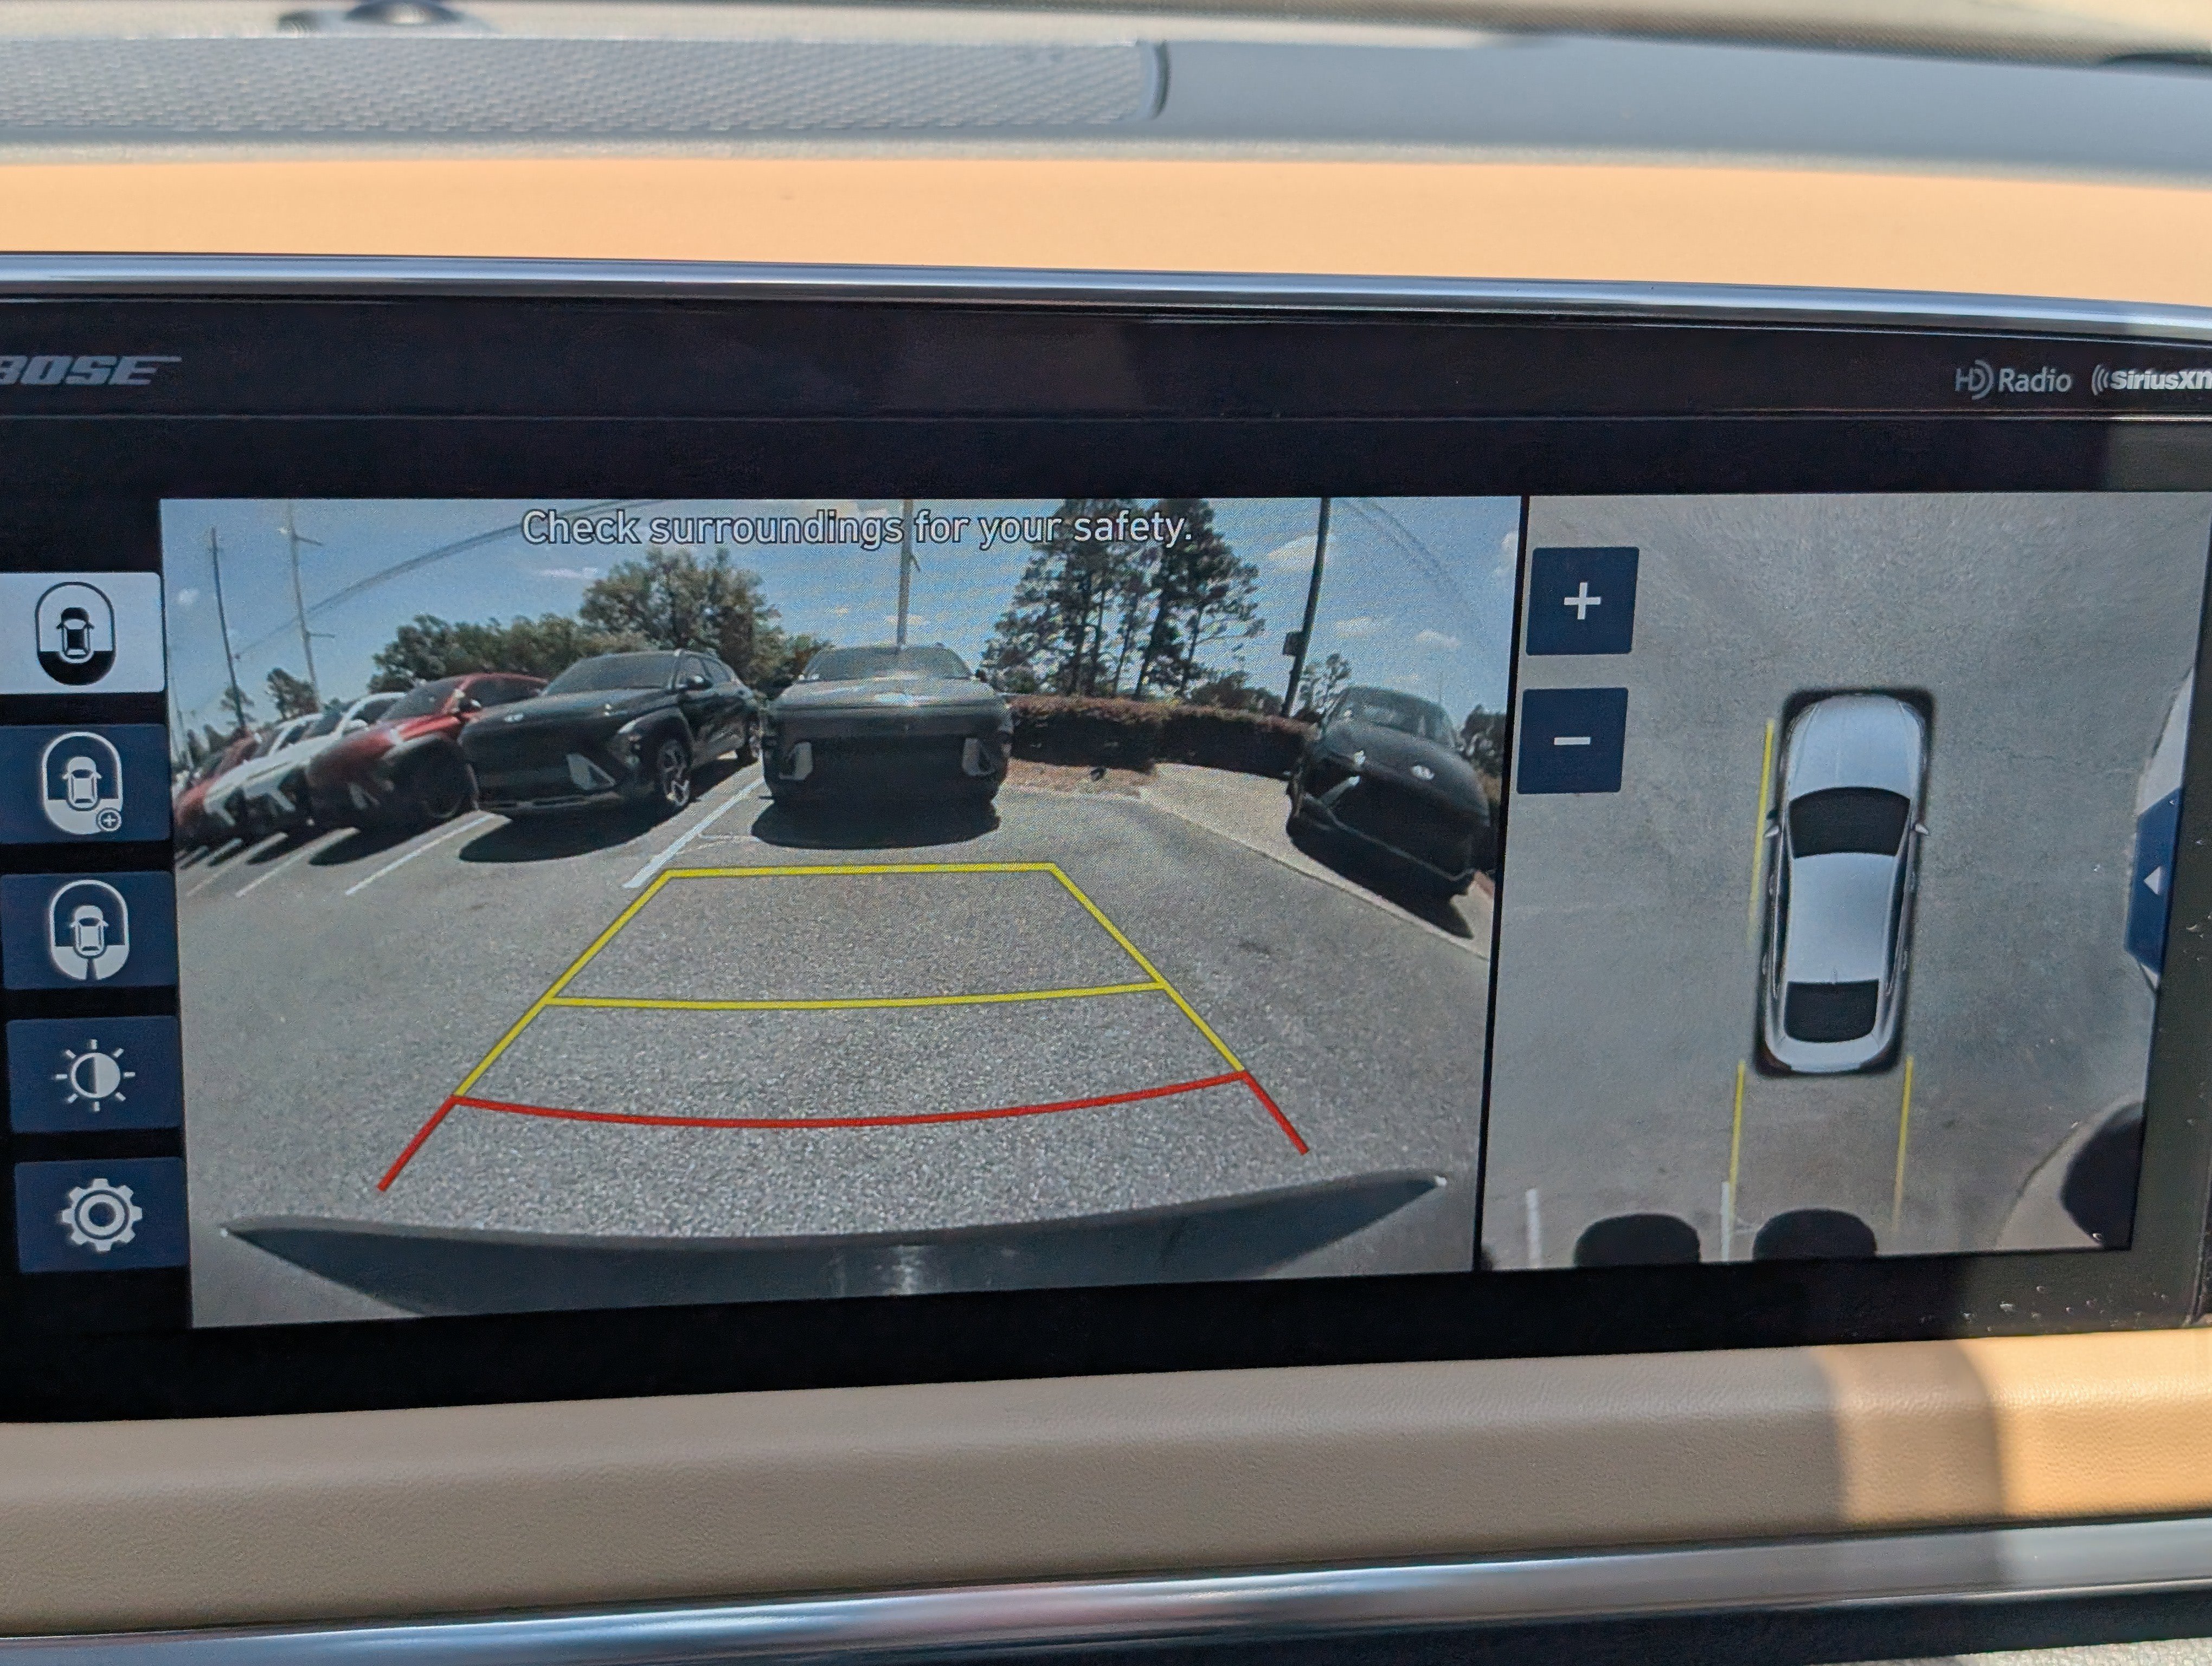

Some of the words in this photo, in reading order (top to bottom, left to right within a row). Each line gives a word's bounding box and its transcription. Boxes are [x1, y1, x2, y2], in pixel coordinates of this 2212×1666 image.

[1998, 366, 2072, 392] Radio
[522, 509, 642, 544] Check
[651, 510, 904, 551] surroundings
[915, 509, 970, 543] for
[979, 516, 1063, 551] your
[1072, 510, 1192, 549] safety.
